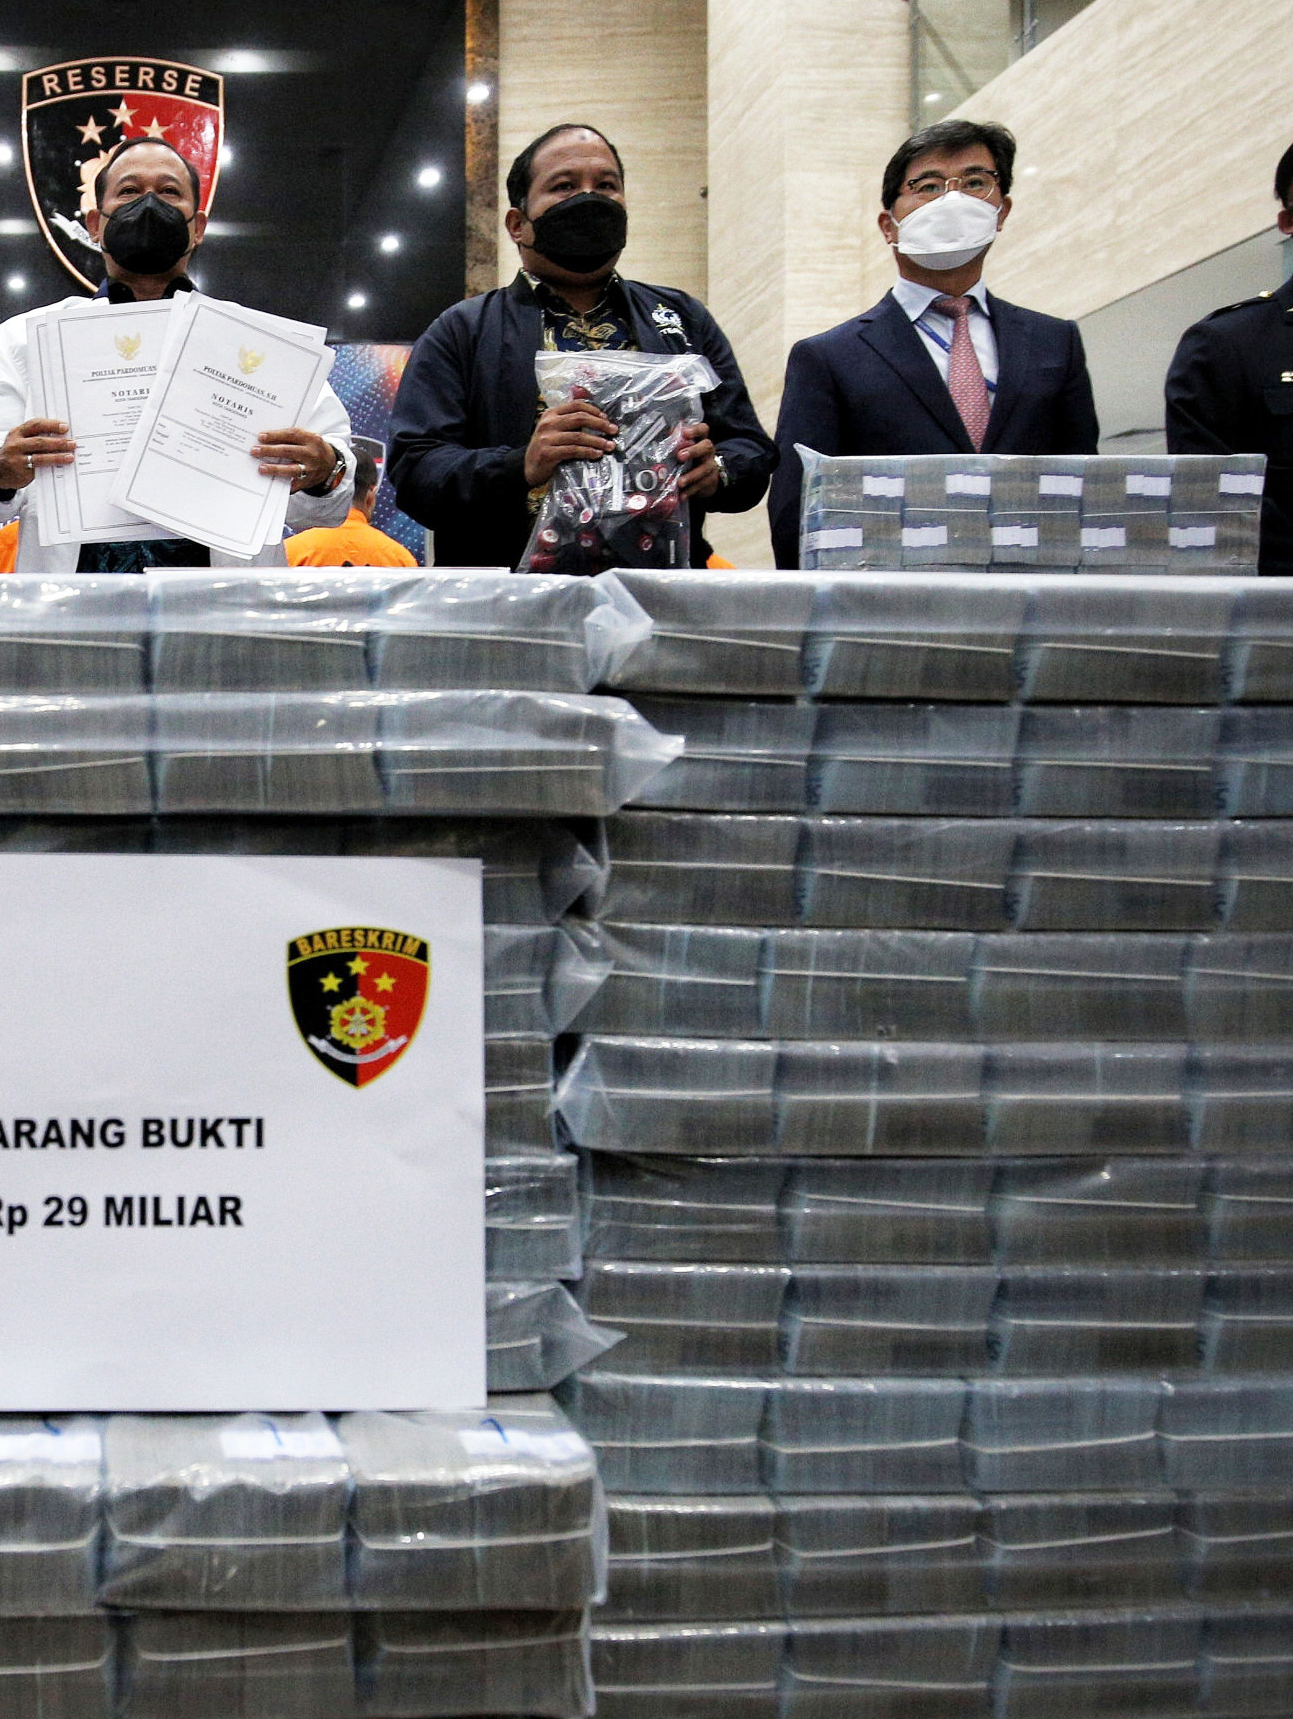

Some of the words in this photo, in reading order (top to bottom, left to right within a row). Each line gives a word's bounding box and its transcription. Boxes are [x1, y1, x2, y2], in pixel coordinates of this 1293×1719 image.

[41, 65, 203, 97] RESERSE
[111, 388, 150, 398] NOTARI
[210, 392, 254, 416] NOTARIS
[295, 930, 421, 957] BARESKRIM
[141, 1117, 265, 1149] BUKTI
[42, 1195, 89, 1227] 29
[103, 1195, 243, 1228] MILIAR
